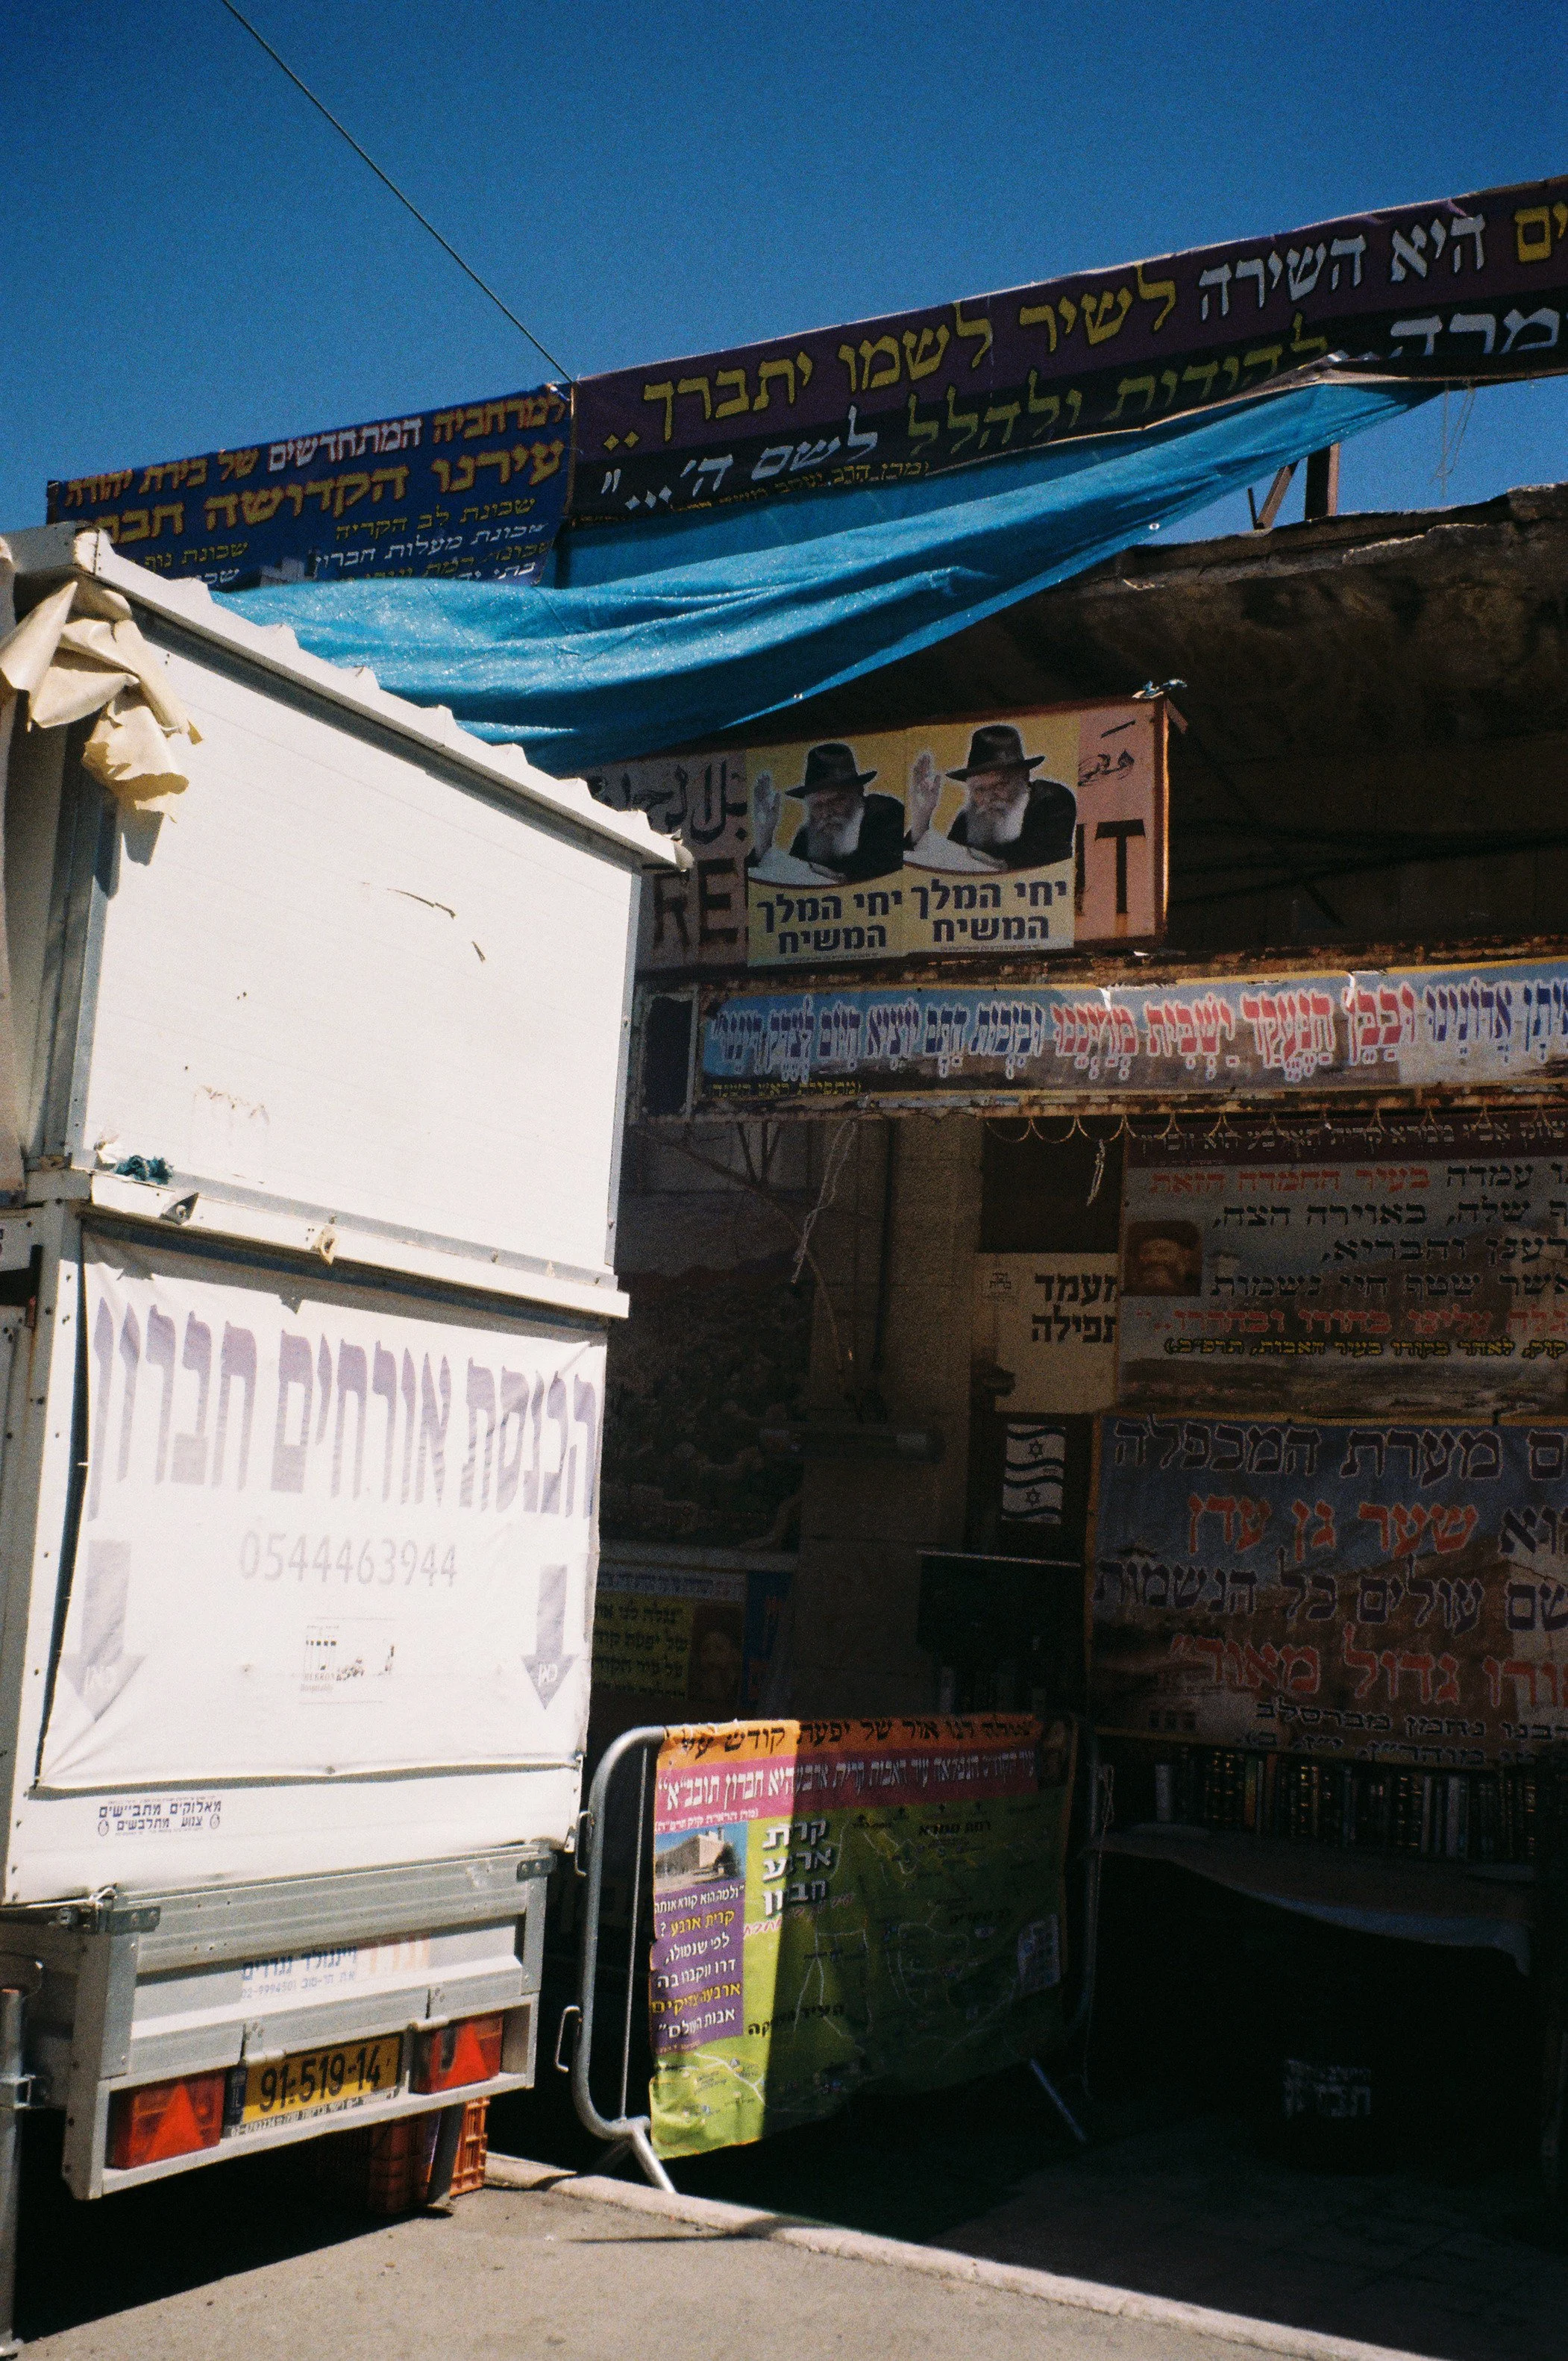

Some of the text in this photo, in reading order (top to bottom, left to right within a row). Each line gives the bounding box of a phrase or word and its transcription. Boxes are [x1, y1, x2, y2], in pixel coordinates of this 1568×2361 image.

[1390, 213, 1486, 283] היא
[1199, 233, 1367, 322] השירה
[1020, 263, 1176, 353] לשיר
[838, 300, 993, 394] לשמו
[909, 370, 1082, 457] ולהלל
[267, 417, 423, 472] המתחדשים
[752, 405, 879, 480] לשם
[218, 448, 260, 482] של
[95, 438, 565, 545] עירנו הקדושה חבר
[336, 498, 536, 541] שכונת לב הקריה
[181, 542, 249, 565] שכונת
[316, 548, 376, 568] חברון
[384, 534, 463, 559] מעלות
[756, 890, 903, 932] יחי המלך
[911, 877, 1068, 920] יחי המלך
[778, 924, 887, 955] המשיח
[932, 915, 1050, 942] המשיח
[1150, 1171, 1226, 1195] הזאת
[1355, 1167, 1431, 1194] בעיר
[1447, 1164, 1534, 1191] עמדה
[1307, 1201, 1428, 1226] באוירה
[1209, 1274, 1323, 1297] נשמות
[1339, 1273, 1388, 1296] חיי
[87, 1296, 598, 1522] הכנסת אורחים חברון
[1114, 1413, 1323, 1478] המכפלה
[1339, 1429, 1503, 1490] מערת
[1188, 1492, 1568, 1564] וא שער גן עדן
[239, 1530, 459, 1589] 0544463944
[1092, 1558, 1258, 1615] הנשמות
[1278, 1545, 1338, 1621] כל
[1356, 1552, 1486, 1637] עולים
[1342, 1621, 1461, 1706] גדול
[1255, 1695, 1393, 1731] מברסלב
[1405, 1715, 1487, 1739] נחמן
[725, 1727, 785, 1754] קודש
[796, 1722, 850, 1747] יפעת
[859, 1719, 893, 1742] של
[901, 1719, 940, 1740] אור
[723, 1769, 765, 1810] חברון
[768, 1767, 795, 1798] היא
[169, 1800, 222, 1816] מאלוקים
[116, 1818, 170, 1832] מתלבשים
[671, 1916, 703, 1937] ארבע
[705, 1910, 736, 1929] קרית
[710, 1931, 731, 1951] לפי
[656, 1973, 680, 1989] בה
[714, 1958, 736, 1975] דרו
[704, 2007, 736, 2028] אבות
